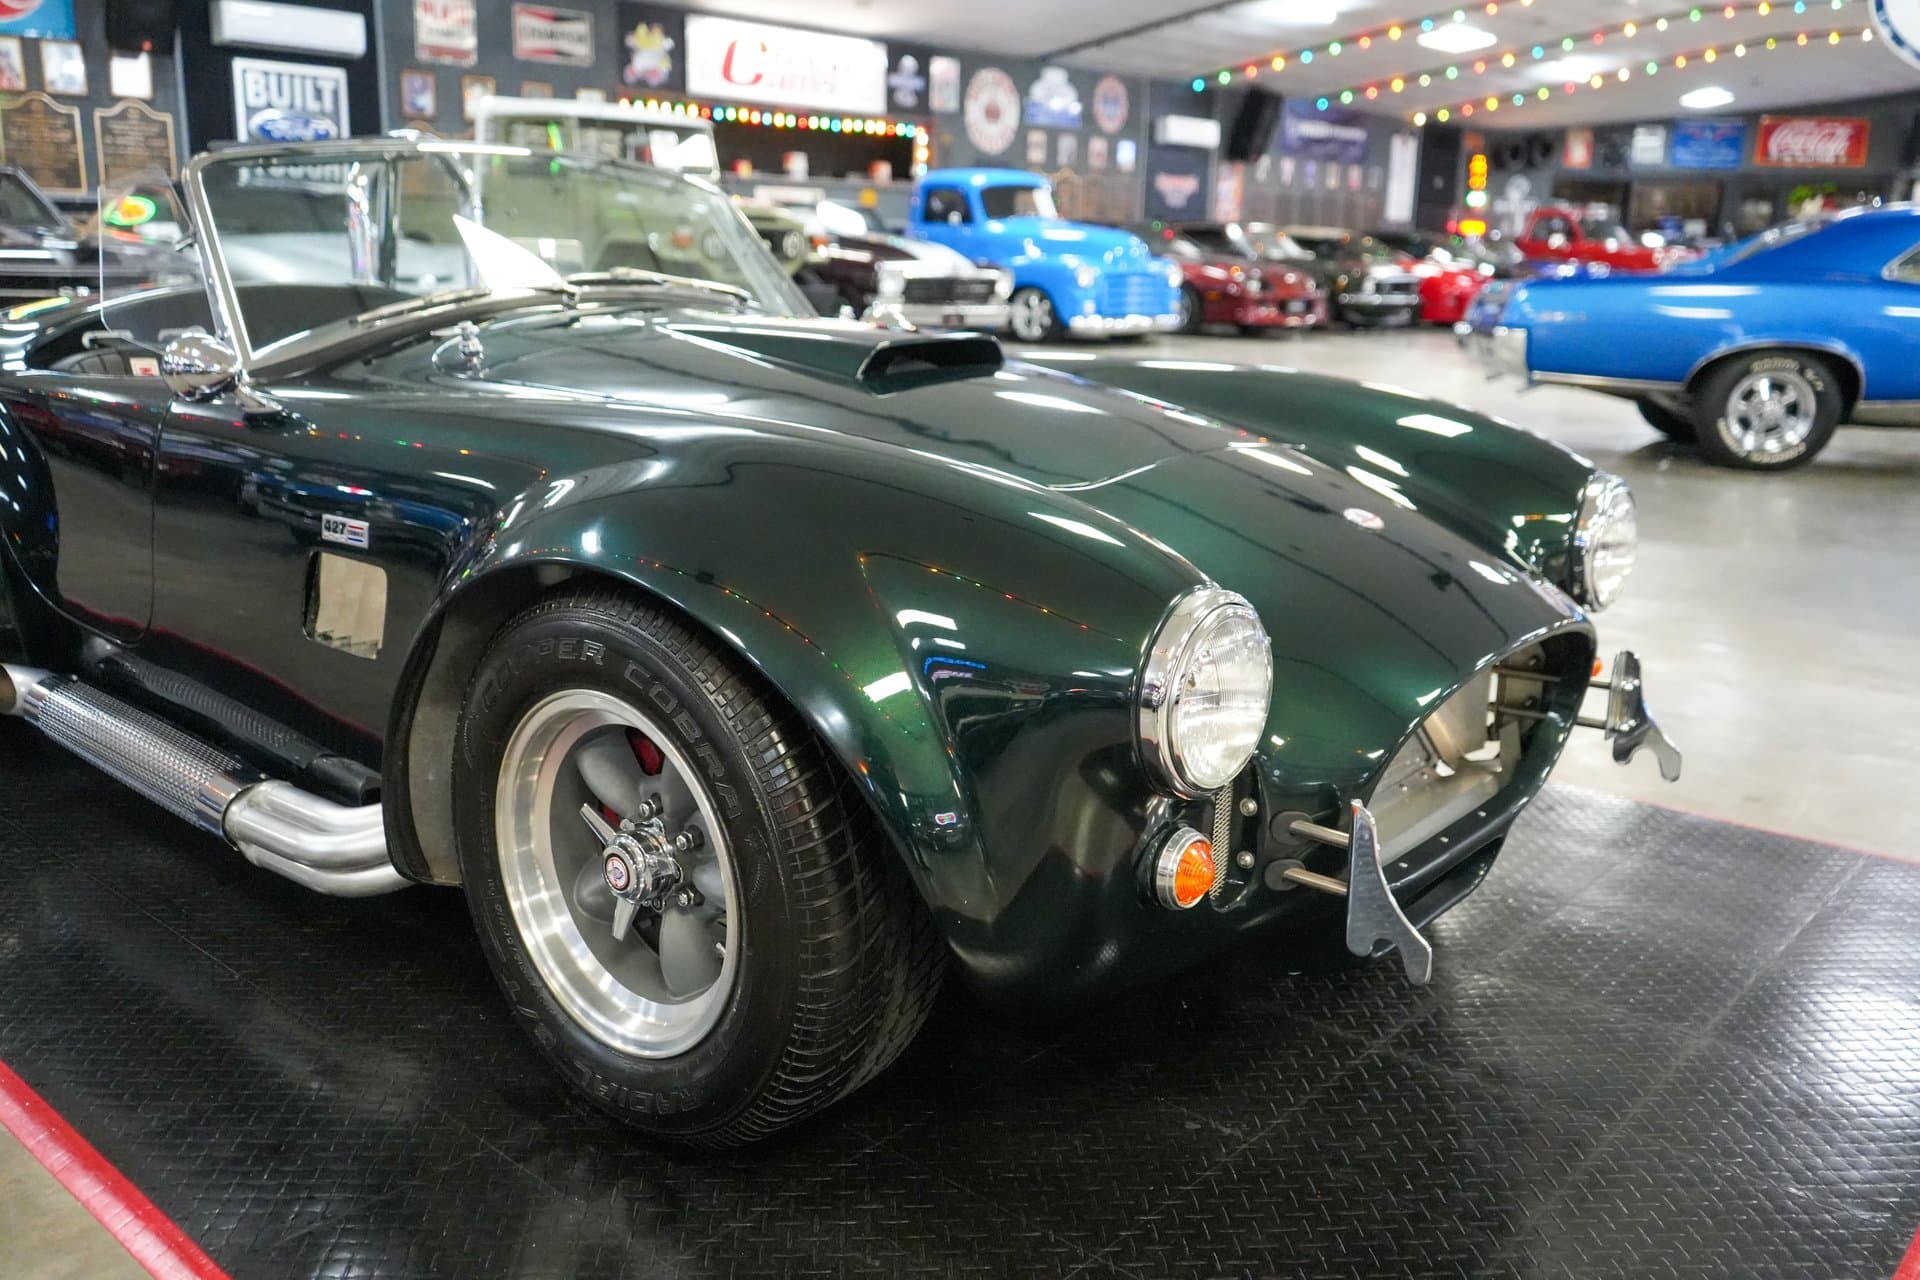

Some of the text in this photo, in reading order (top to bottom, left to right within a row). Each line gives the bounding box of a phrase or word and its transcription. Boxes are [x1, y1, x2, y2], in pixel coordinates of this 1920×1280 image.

[246, 68, 338, 113] BUILT
[324, 519, 346, 535] 427
[624, 659, 743, 820] COBRA
